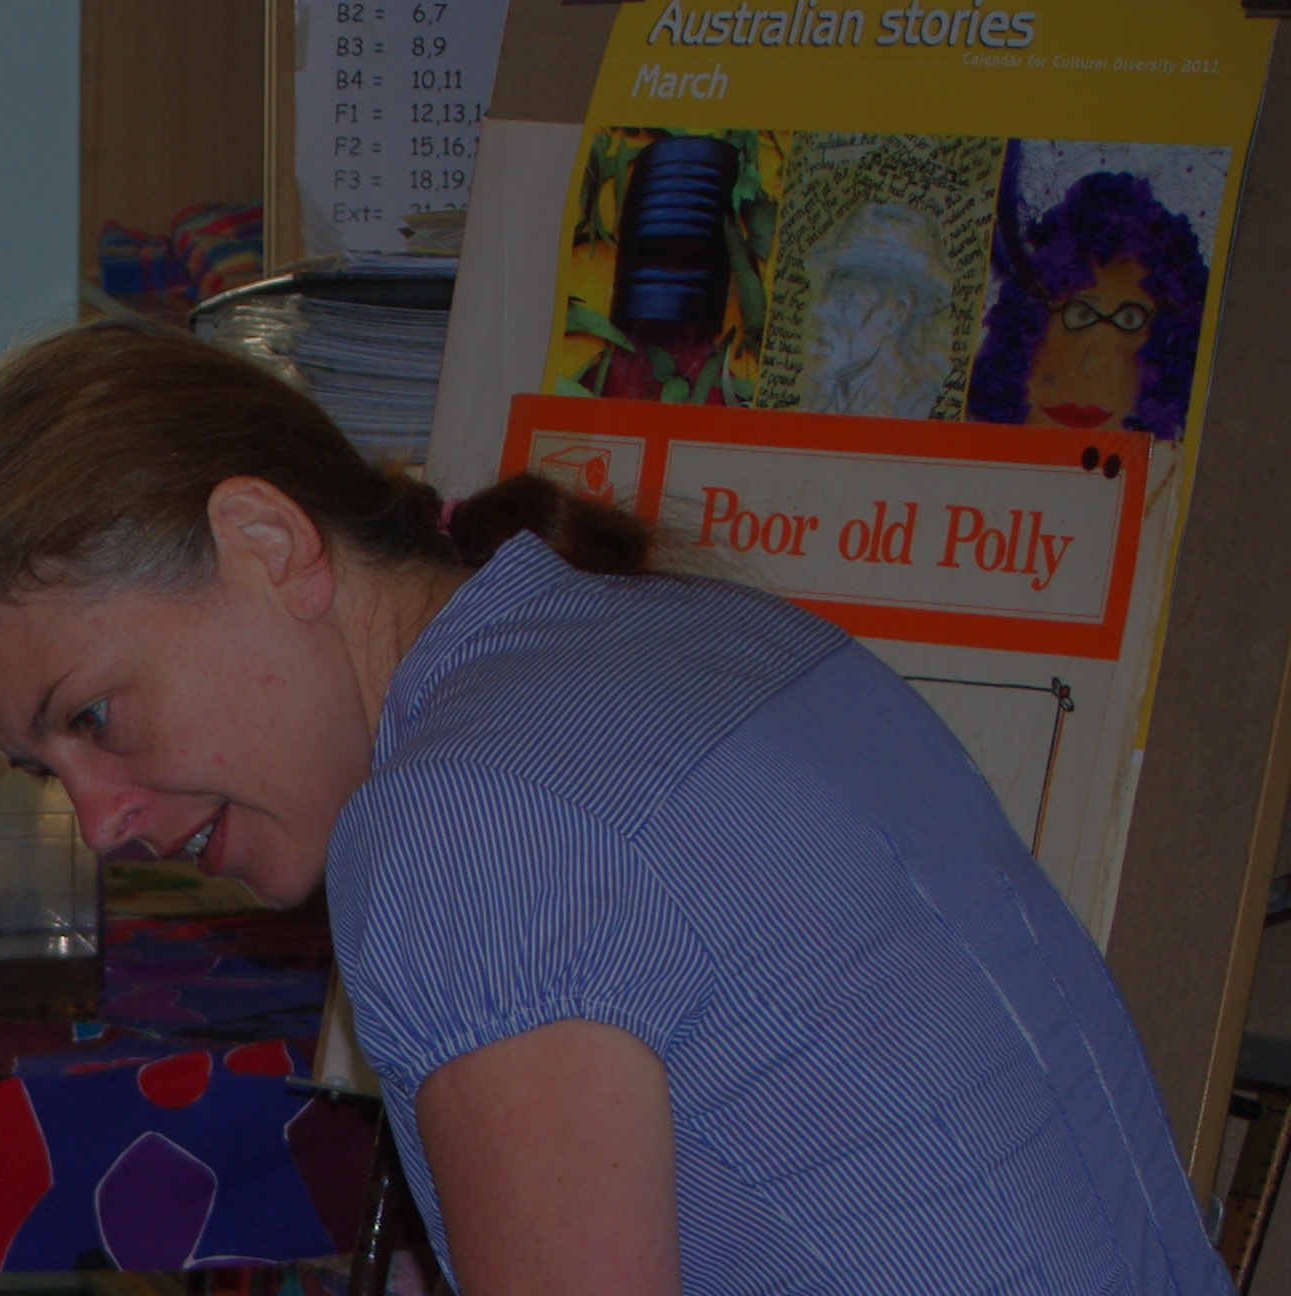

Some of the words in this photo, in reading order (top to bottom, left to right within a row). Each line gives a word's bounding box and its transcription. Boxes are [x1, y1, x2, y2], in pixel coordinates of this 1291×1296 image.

[337, 4, 365, 23] B2
[412, 4, 448, 25] 6,7
[647, 0, 865, 46] Australian
[876, 0, 1037, 48] stories
[337, 37, 364, 56] B3
[412, 37, 447, 59] 8,9
[962, 52, 1022, 67] Calendar
[1027, 54, 1047, 68] for
[1052, 55, 1108, 71] Cultural
[1113, 57, 1177, 75] Diversity
[1181, 59, 1219, 74] 2011
[336, 70, 364, 90] B4
[412, 70, 462, 91] 10,11
[631, 64, 729, 99] March
[335, 104, 359, 123] F1
[335, 137, 361, 156] F2
[335, 170, 361, 190] F3
[697, 485, 819, 557] Poor
[838, 501, 916, 566] old
[935, 503, 1075, 592] Polly
